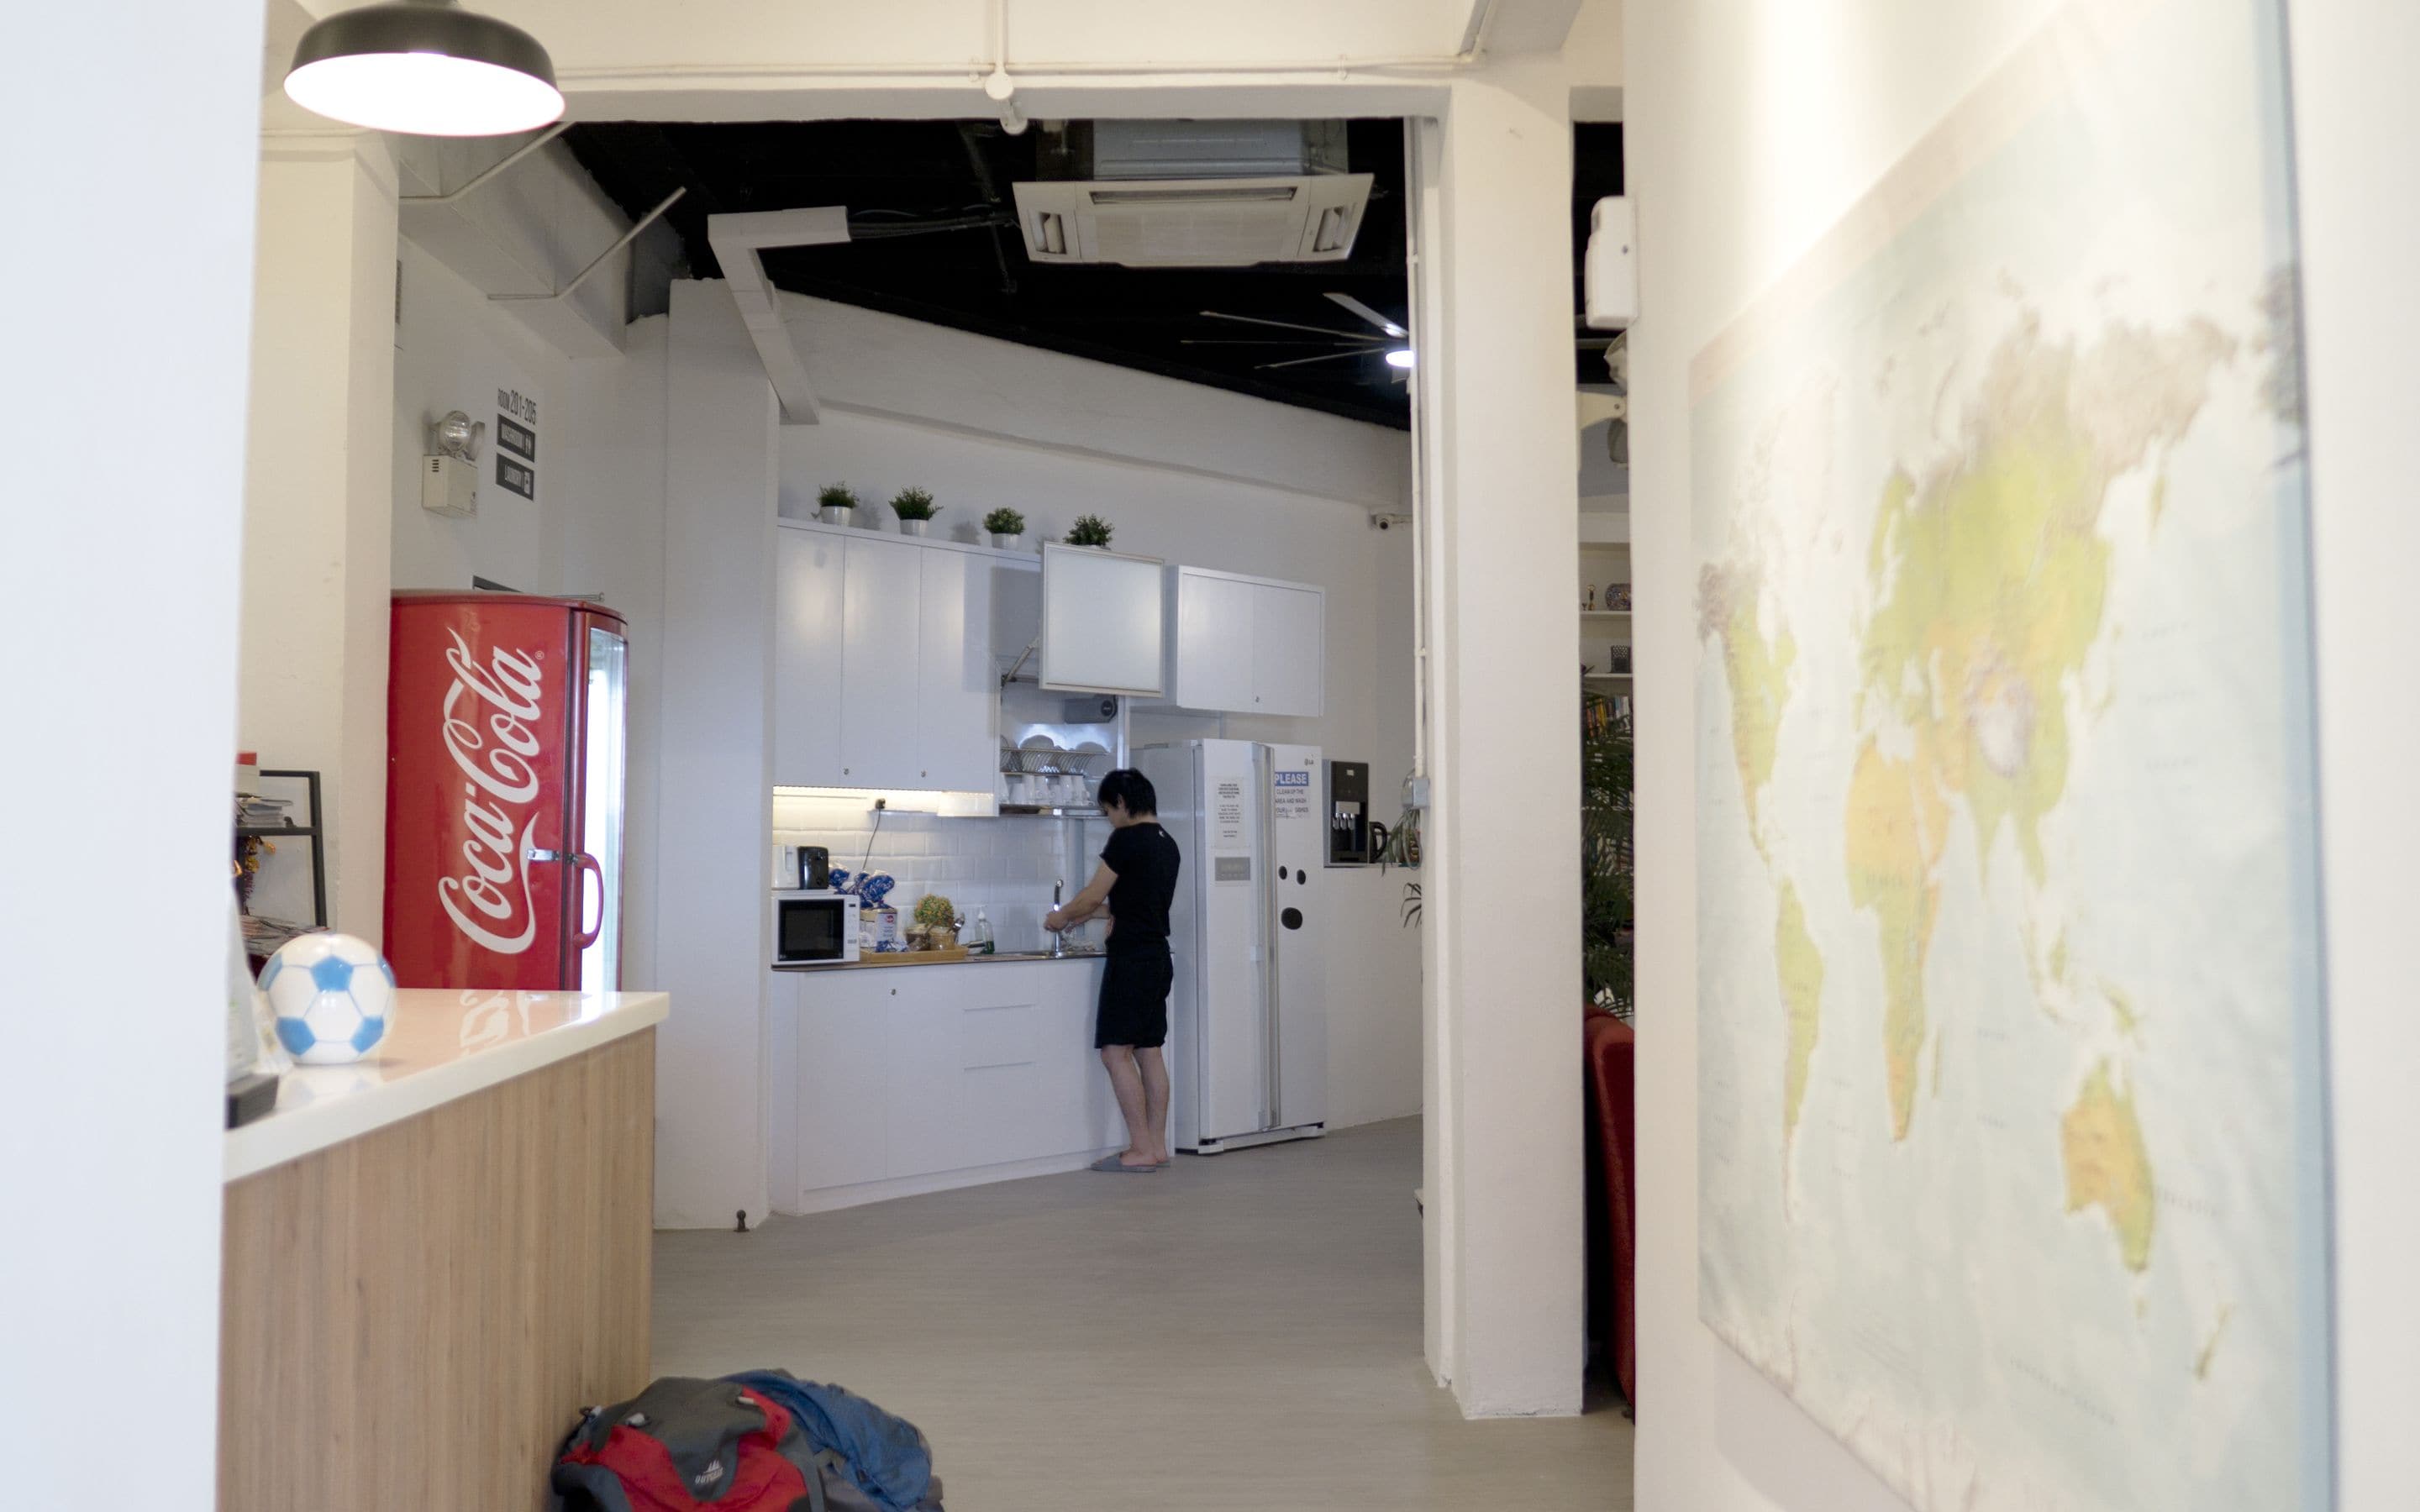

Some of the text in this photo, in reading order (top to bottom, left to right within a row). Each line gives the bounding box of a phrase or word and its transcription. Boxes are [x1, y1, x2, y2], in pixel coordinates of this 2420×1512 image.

[510, 390, 536, 425] 201-205
[438, 626, 544, 955] Coca-Cola
[1275, 773, 1307, 785] PLEASE
